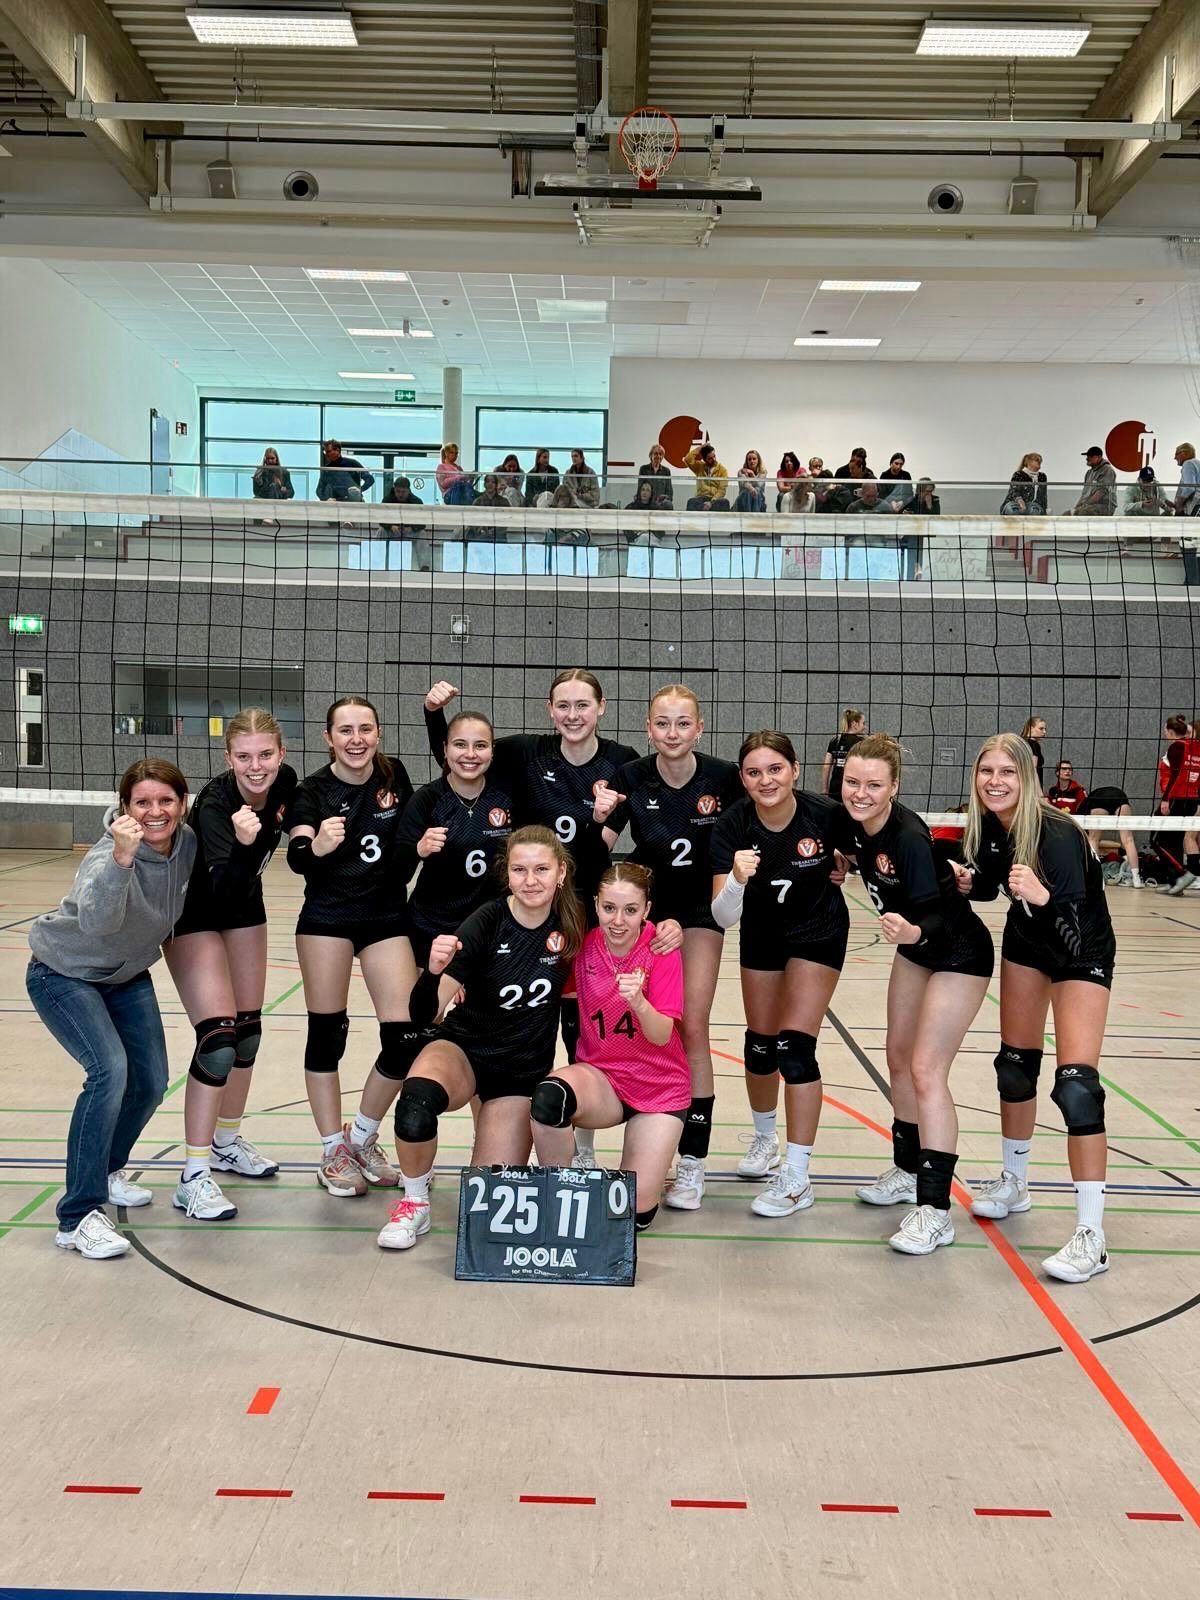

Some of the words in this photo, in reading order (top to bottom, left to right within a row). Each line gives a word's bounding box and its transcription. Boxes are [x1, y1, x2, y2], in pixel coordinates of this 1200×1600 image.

[555, 815, 577, 843] 9
[360, 834, 381, 863] 3
[670, 838, 693, 866] 2
[465, 849, 487, 878] 6
[770, 879, 793, 904] 7
[499, 978, 552, 1010] 22
[591, 1009, 639, 1040] 14
[501, 1171, 529, 1180] JOOLA
[557, 1172, 586, 1185] JOOLA
[468, 1176, 488, 1212] 2
[489, 1185, 539, 1235] 25
[555, 1189, 590, 1239] 11
[608, 1180, 628, 1215] 0
